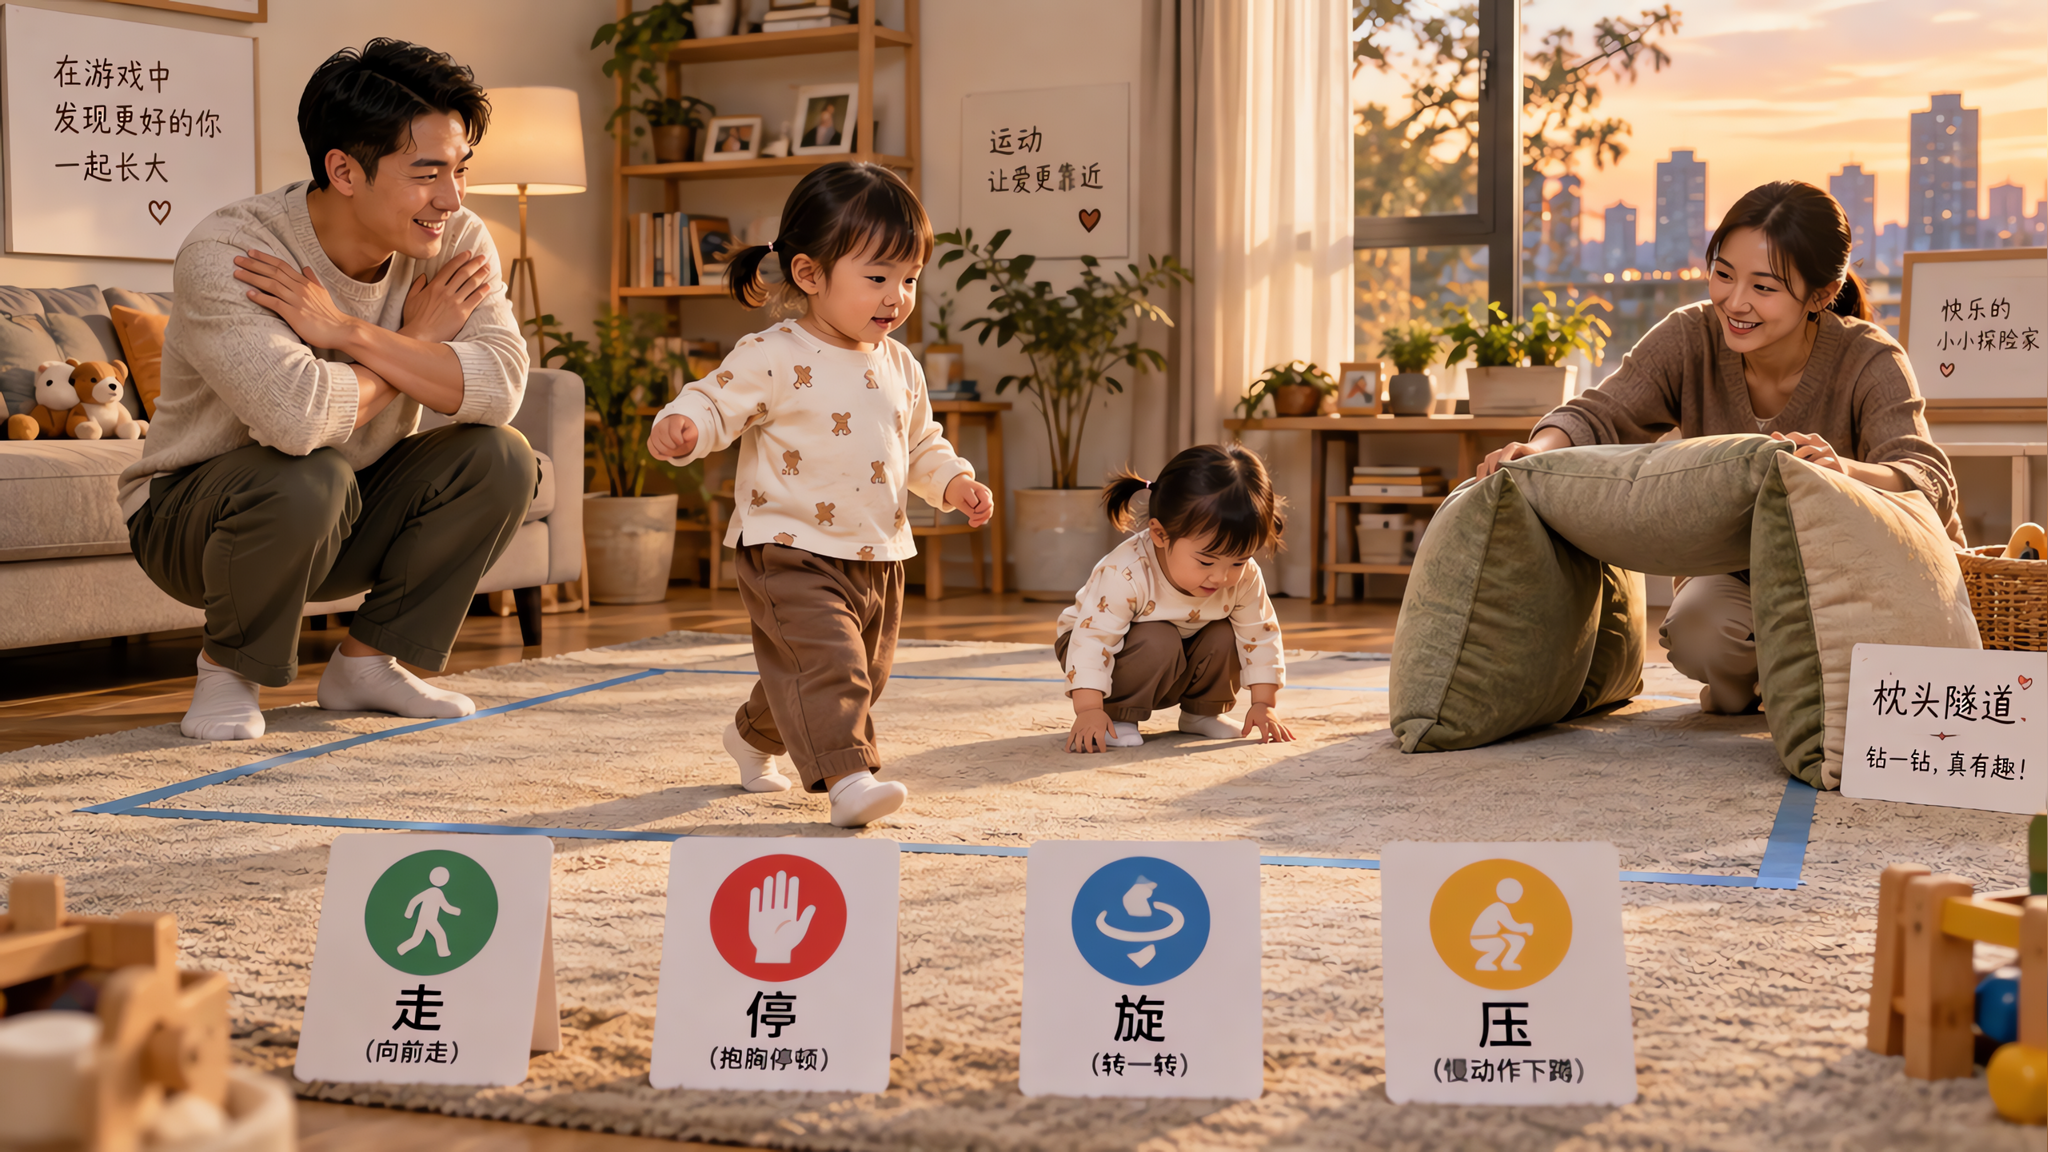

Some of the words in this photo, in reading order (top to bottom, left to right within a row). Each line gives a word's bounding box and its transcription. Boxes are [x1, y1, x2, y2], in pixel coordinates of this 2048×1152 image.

[53, 54, 170, 94] 在游戏中
[54, 101, 222, 139] 发现更好的你
[989, 125, 1043, 155] 运动
[54, 150, 169, 183] 一起长大
[1936, 326, 2040, 352] 小小探险家
[1872, 679, 2016, 725] 枕头隧道
[391, 983, 444, 1031] 走
[746, 990, 797, 1039] 停
[1113, 994, 1166, 1043] 旋
[1479, 1002, 1532, 1049] 压
[365, 1038, 459, 1065] （向前走）
[1091, 1052, 1188, 1078] （转一转）
